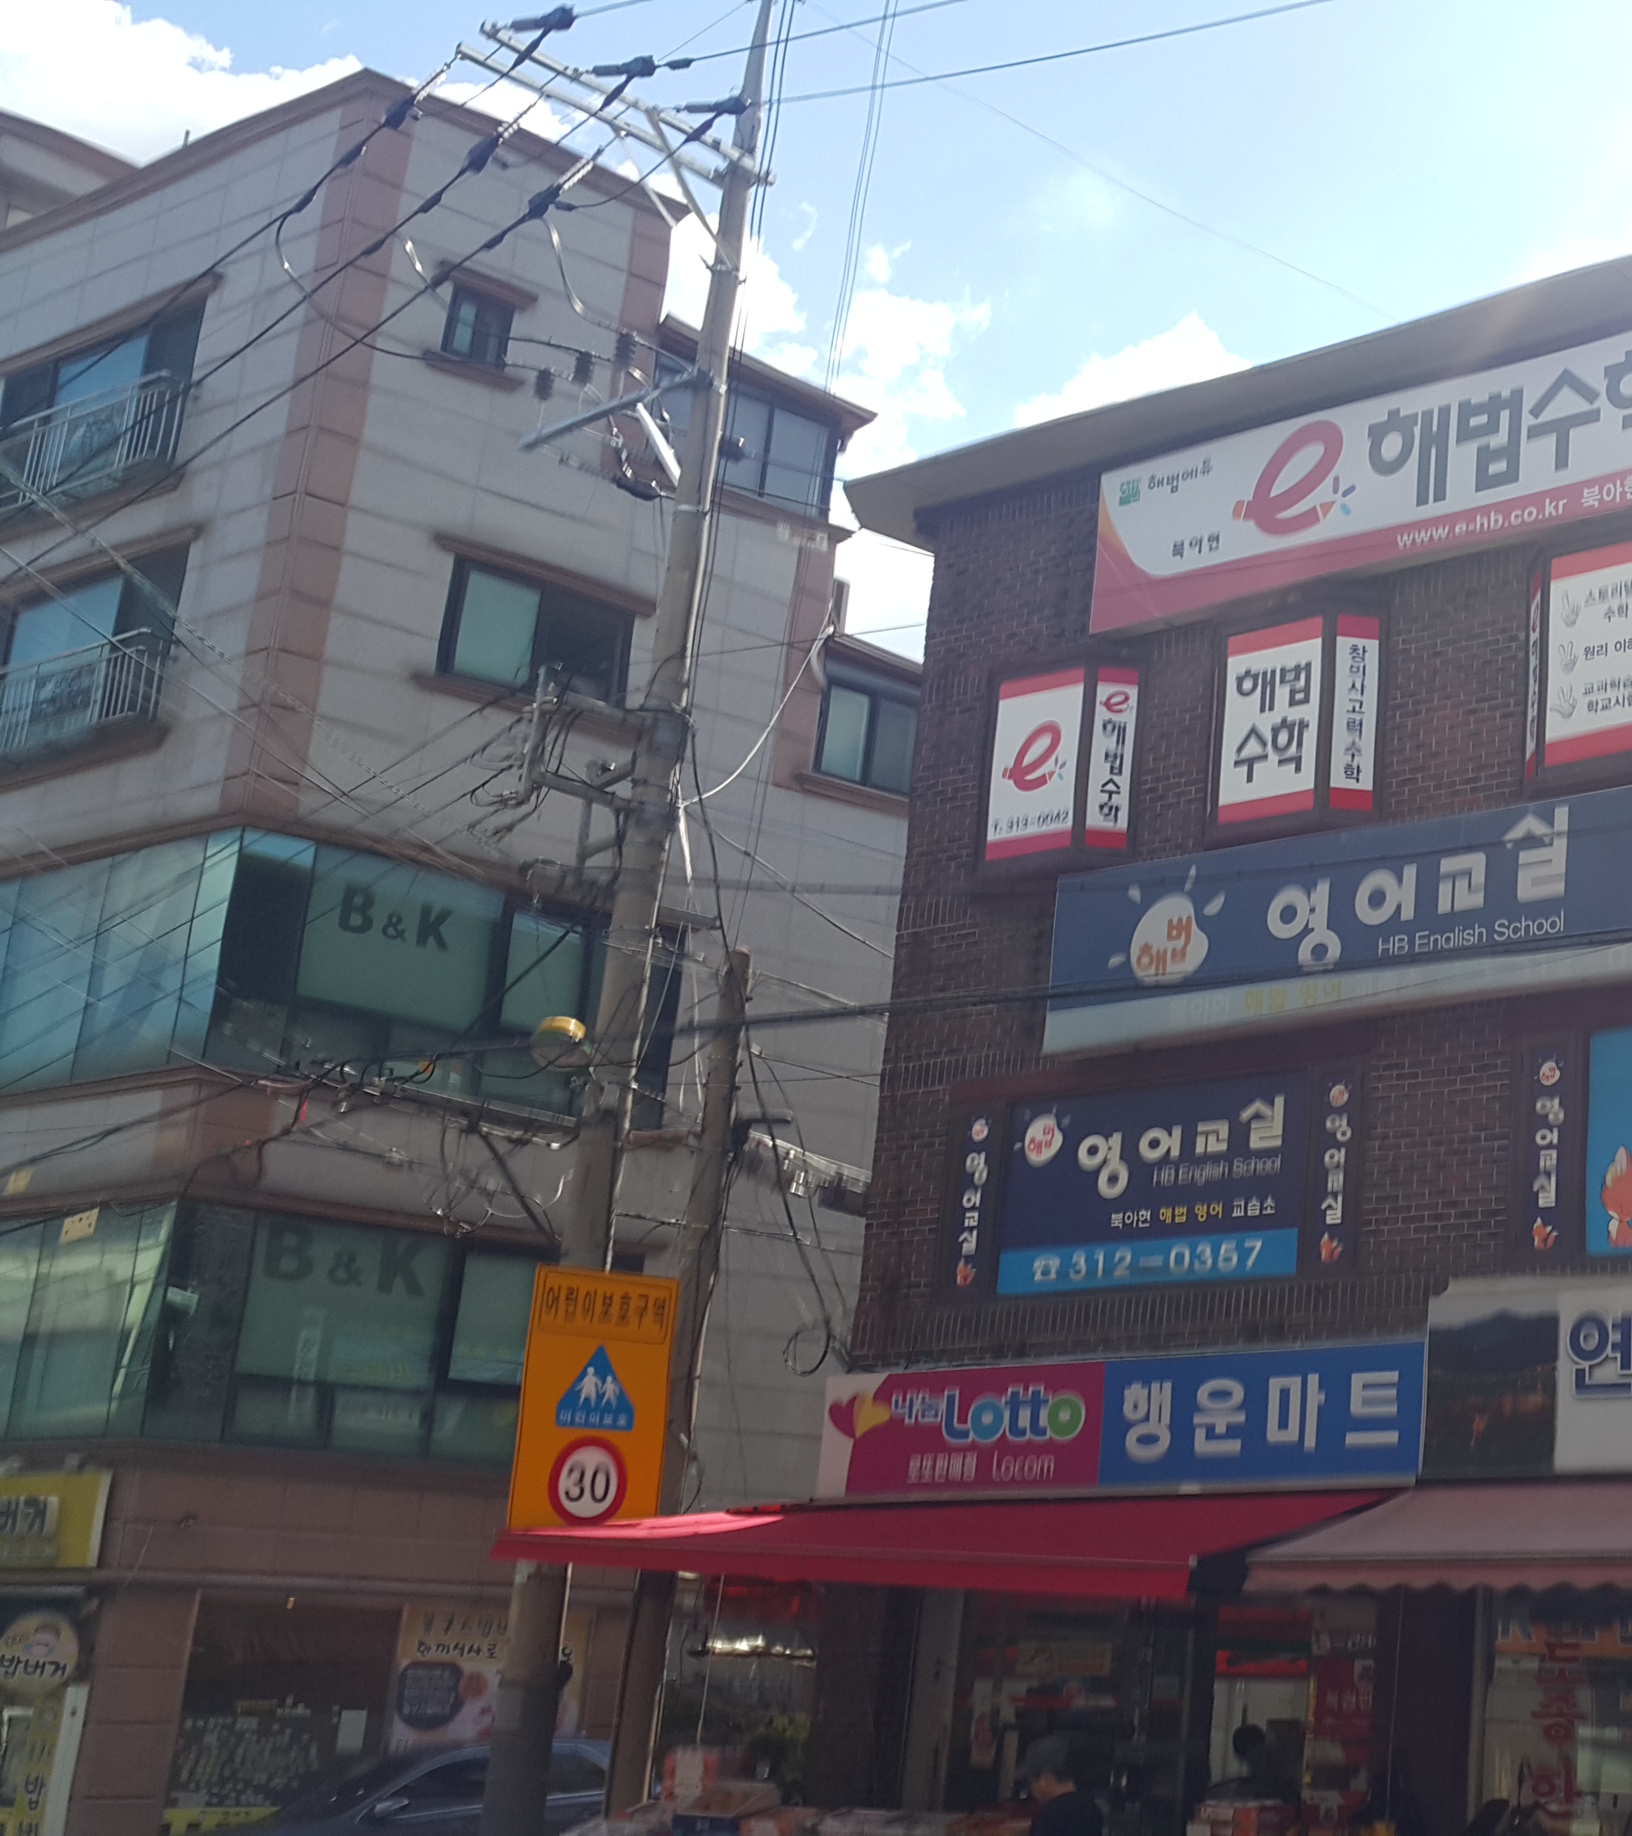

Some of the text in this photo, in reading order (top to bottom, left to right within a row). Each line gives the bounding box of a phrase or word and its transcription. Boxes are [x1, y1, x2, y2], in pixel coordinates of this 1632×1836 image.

[1397, 497, 1567, 550] www.e-hb.co.kr
[1582, 641, 1609, 662] 원리
[1234, 660, 1313, 716] 해법
[1098, 717, 1129, 826] 해법수학
[1233, 715, 1311, 785] 수학
[337, 881, 455, 954] B&K
[1267, 804, 1571, 974] 영어교실
[1377, 907, 1566, 958] HB English School
[1077, 1093, 1286, 1200] 영어교실
[1320, 1112, 1352, 1227] 영어교실
[1532, 1095, 1565, 1210] 영어교실
[957, 1150, 989, 1257] 영어교실
[1110, 1193, 1277, 1230] 북아현 해법 영어 교습소
[941, 1380, 1086, 1443] Lotto
[1122, 1369, 1401, 1465] 행운마트
[563, 1458, 612, 1504] 30
